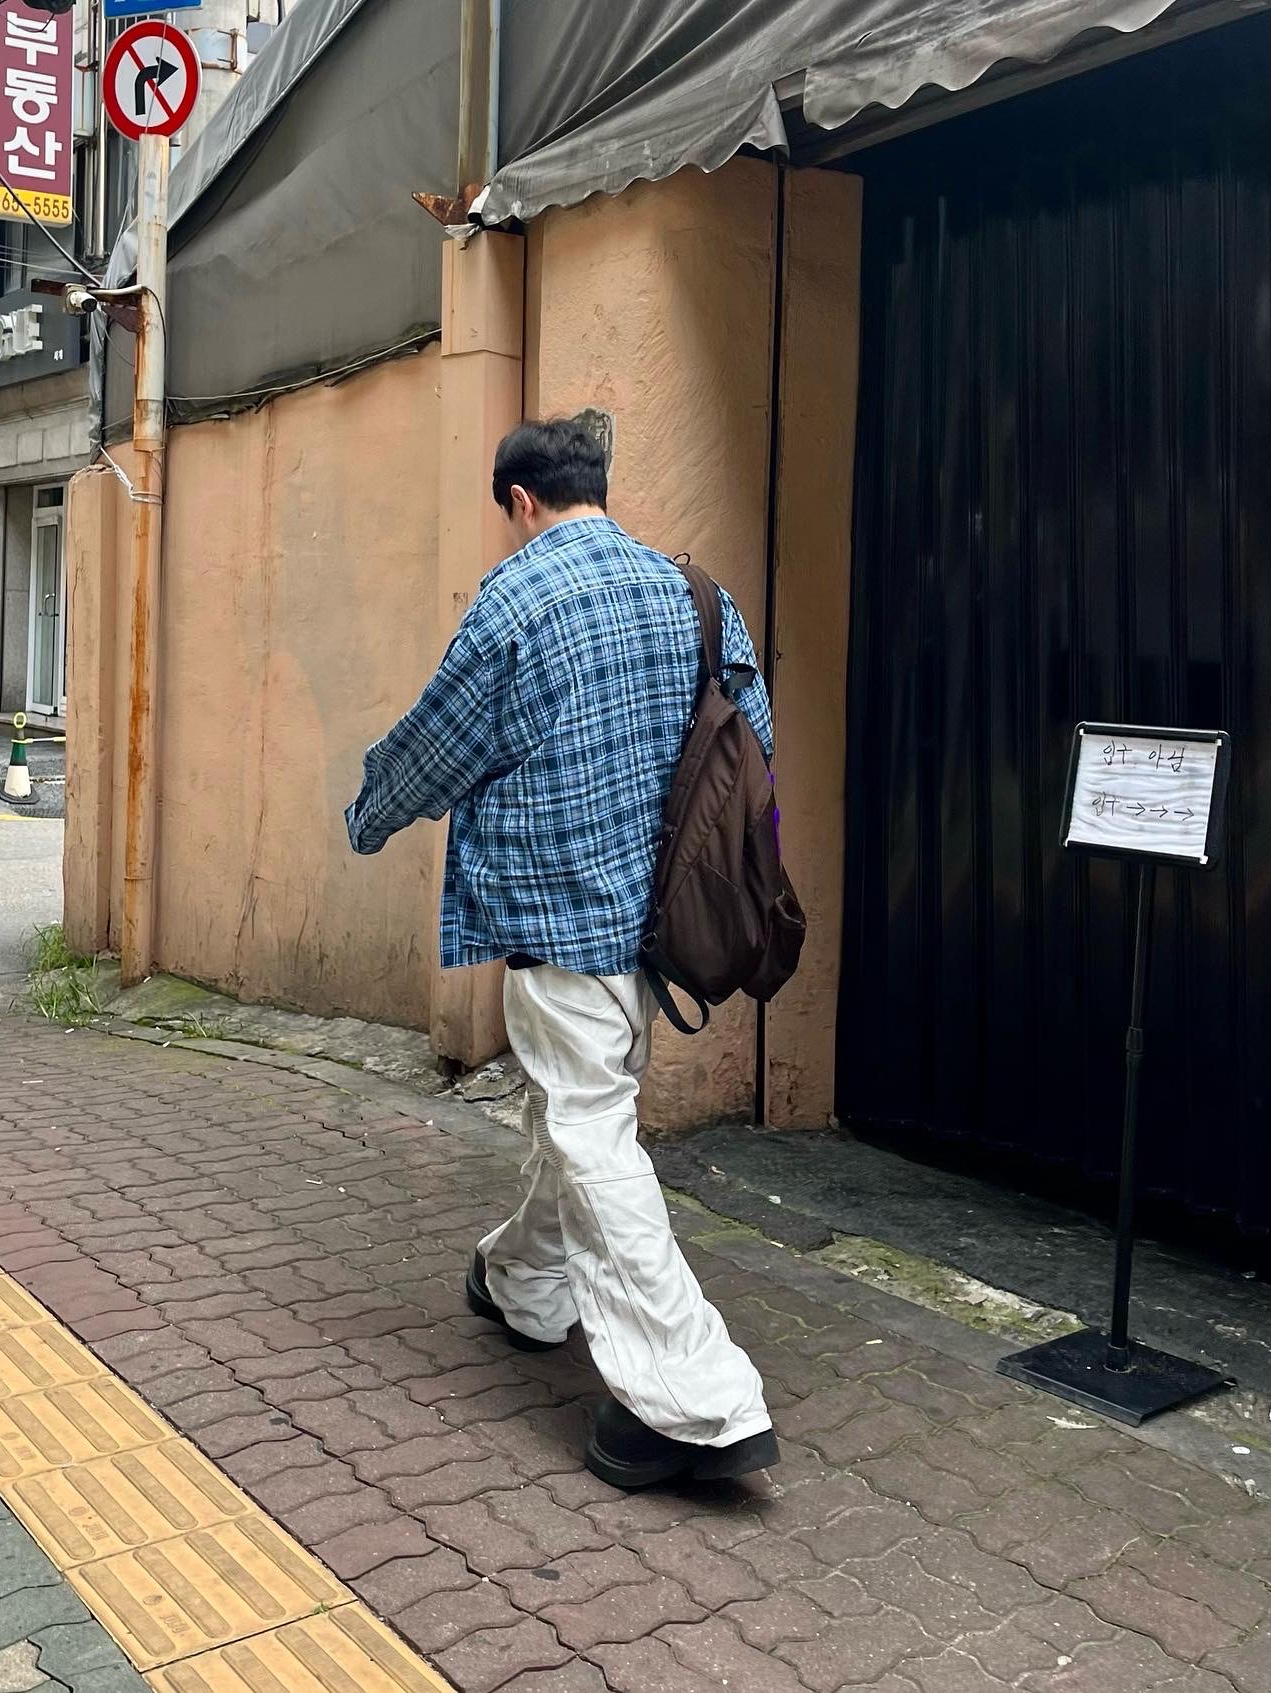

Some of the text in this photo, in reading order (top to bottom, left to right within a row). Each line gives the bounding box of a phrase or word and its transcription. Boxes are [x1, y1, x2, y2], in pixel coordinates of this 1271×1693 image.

[3, 12, 63, 181] 부동산
[2, 192, 70, 219] 65-5555
[1103, 740, 1133, 766] 입구
[1092, 791, 1120, 817] 입구
